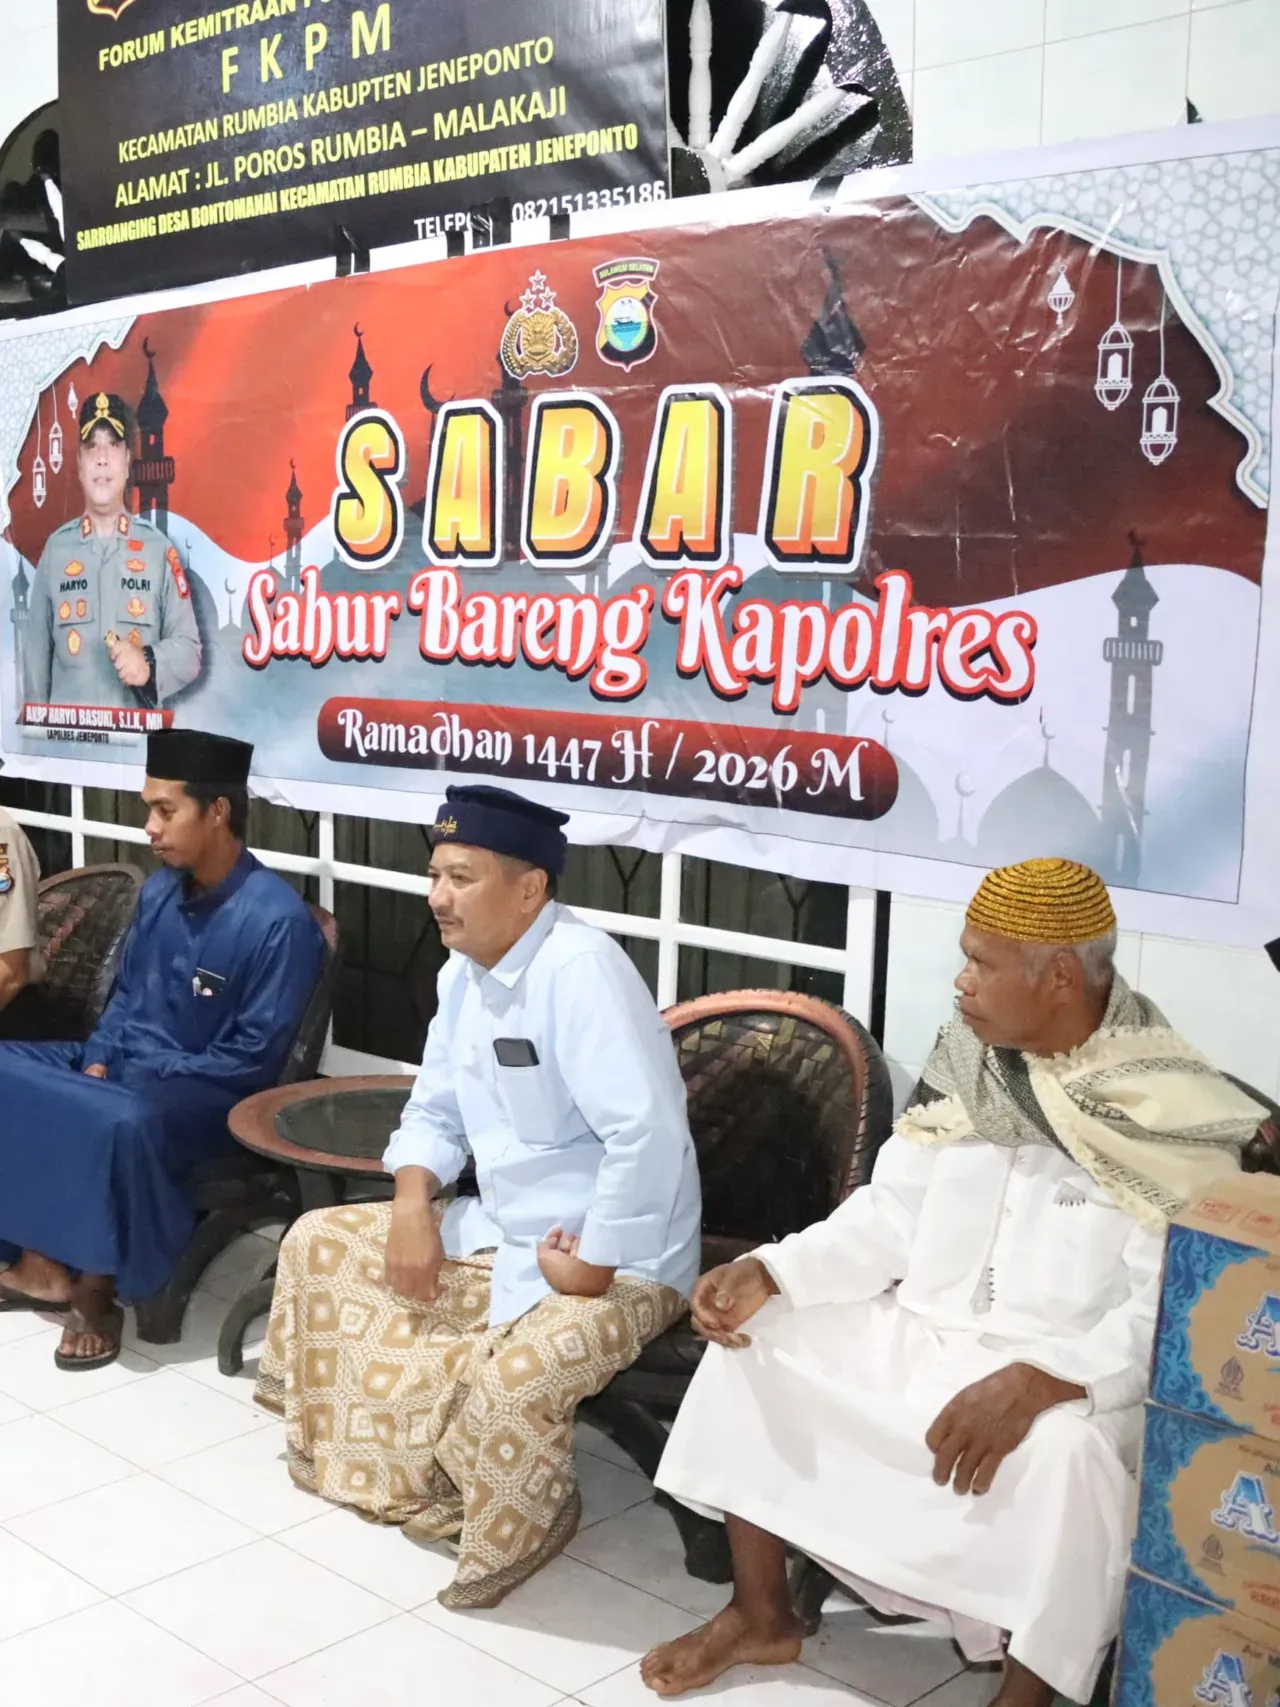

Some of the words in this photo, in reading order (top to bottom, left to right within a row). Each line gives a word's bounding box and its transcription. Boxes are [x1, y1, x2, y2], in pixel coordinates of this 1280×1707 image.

[99, 30, 165, 71] FORUM
[171, 0, 296, 49] KEMITRAAN
[115, 168, 190, 208] ALAMAT
[205, 161, 229, 188] JL.
[234, 142, 306, 182] POROS
[311, 120, 407, 166] RUMBIA
[434, 85, 567, 141] MALAKAJI
[119, 118, 218, 163] KECAMATAN
[223, 101, 298, 137] RUMBIA
[302, 70, 412, 118] KABUPTEN
[417, 36, 554, 92] JENEPONTO
[77, 216, 157, 250] SARROANGING
[158, 209, 190, 235] DESA
[191, 190, 278, 228] BONTOMANAI
[280, 173, 366, 211] KECAMATAN
[368, 161, 431, 195] RUMBIA
[433, 142, 531, 183] KABUPATEN
[535, 123, 639, 166] JENEPONTO
[331, 377, 881, 571] SABAR
[60, 579, 88, 592] HARYO
[121, 578, 151, 591] POLRI
[244, 571, 401, 668] Sahur
[410, 567, 650, 698] Bareng
[666, 566, 1037, 711] Kapolres
[26, 705, 47, 723] AKBP
[48, 706, 77, 725] HARYO
[78, 708, 116, 729] BASUKI,
[146, 712, 163, 730] MH
[337, 708, 513, 765] Ramadhan
[522, 734, 600, 785] 1447
[610, 721, 659, 784] H
[693, 744, 795, 791] 2026
[809, 749, 865, 801] M
